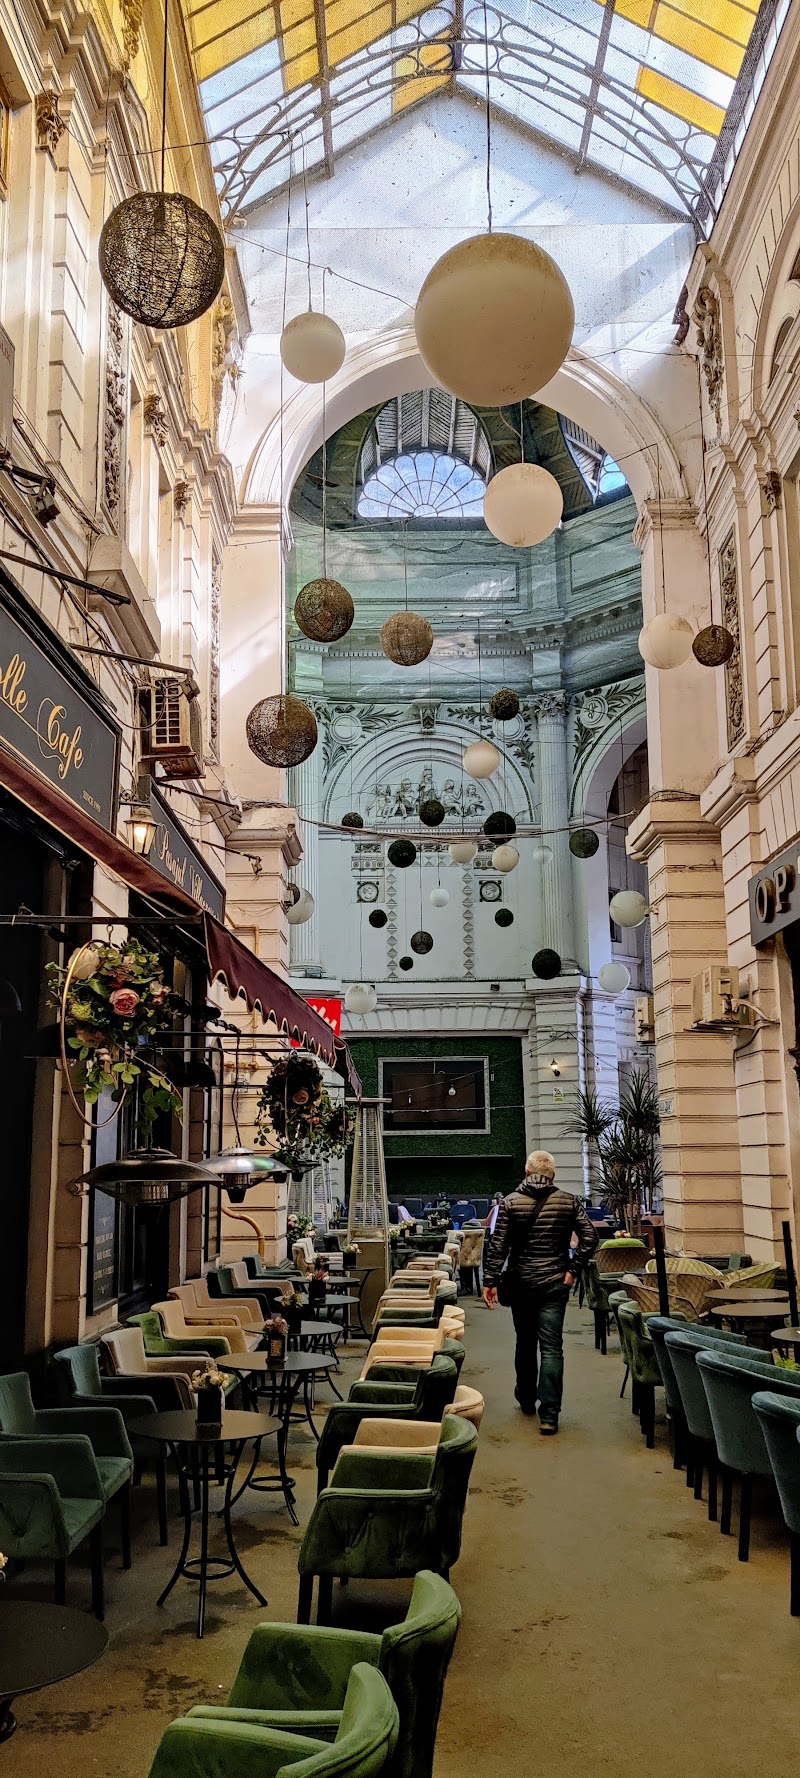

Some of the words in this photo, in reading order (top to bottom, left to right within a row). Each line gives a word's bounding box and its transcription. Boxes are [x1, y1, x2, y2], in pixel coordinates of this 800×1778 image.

[0, 653, 29, 713] lle
[37, 698, 84, 780] Cafe
[755, 855, 800, 923] OP
